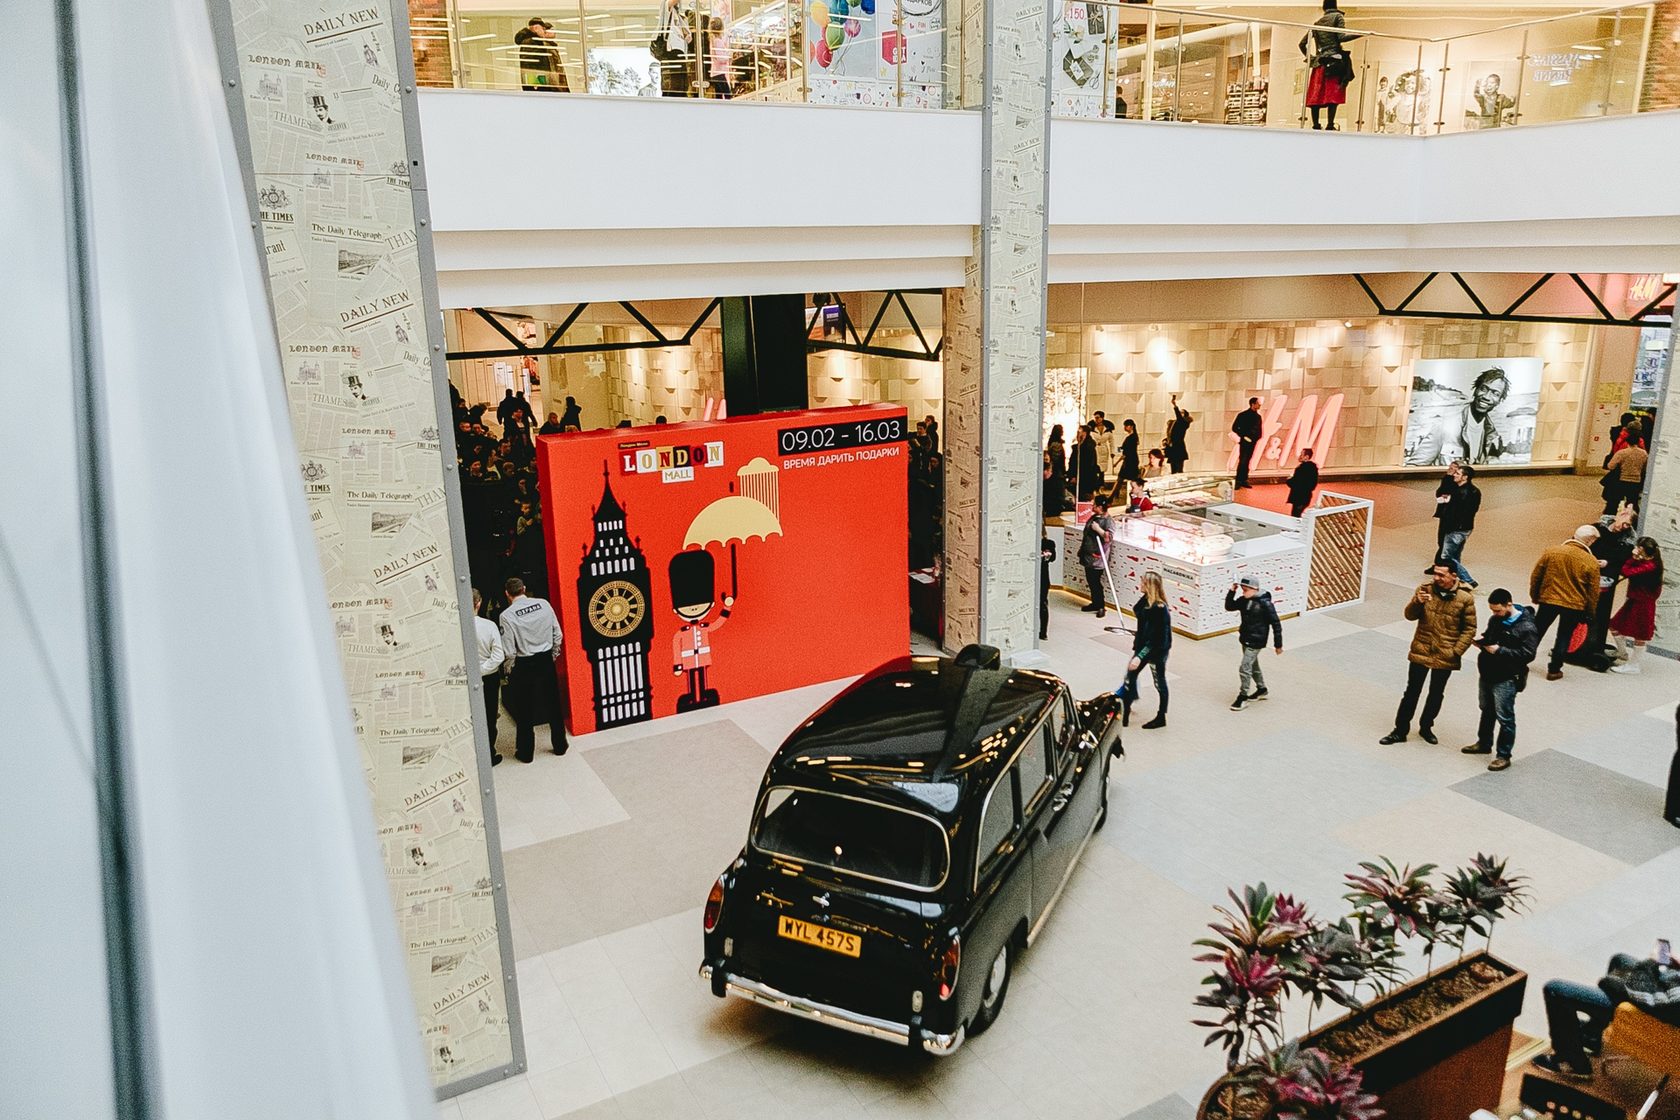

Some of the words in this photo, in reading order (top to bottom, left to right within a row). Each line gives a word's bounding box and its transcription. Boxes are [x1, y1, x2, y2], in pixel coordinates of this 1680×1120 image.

[303, 14, 345, 36] DAILY
[1070, 8, 1085, 20] 150
[372, 74, 390, 92] Daily
[272, 212, 294, 222] TIMES
[312, 223, 325, 232] The
[327, 225, 346, 236] Daily
[349, 227, 383, 240] Telegraph
[340, 299, 380, 323] DAILY
[403, 351, 420, 366] Daily
[781, 427, 835, 451] 09.02
[855, 420, 901, 443] 16.03
[623, 444, 721, 472] LONDON
[783, 457, 816, 470] ВРЕМЯ
[817, 453, 855, 467] ДАРИТЬ
[856, 446, 900, 461] ПОДАРКИ
[664, 470, 692, 481] MALL
[310, 484, 331, 492] TIMES
[373, 553, 411, 579] DAILY
[404, 781, 439, 807] DAILY
[785, 919, 811, 940] WYL
[816, 928, 855, 952] 457S
[432, 984, 466, 1011] DAILY
